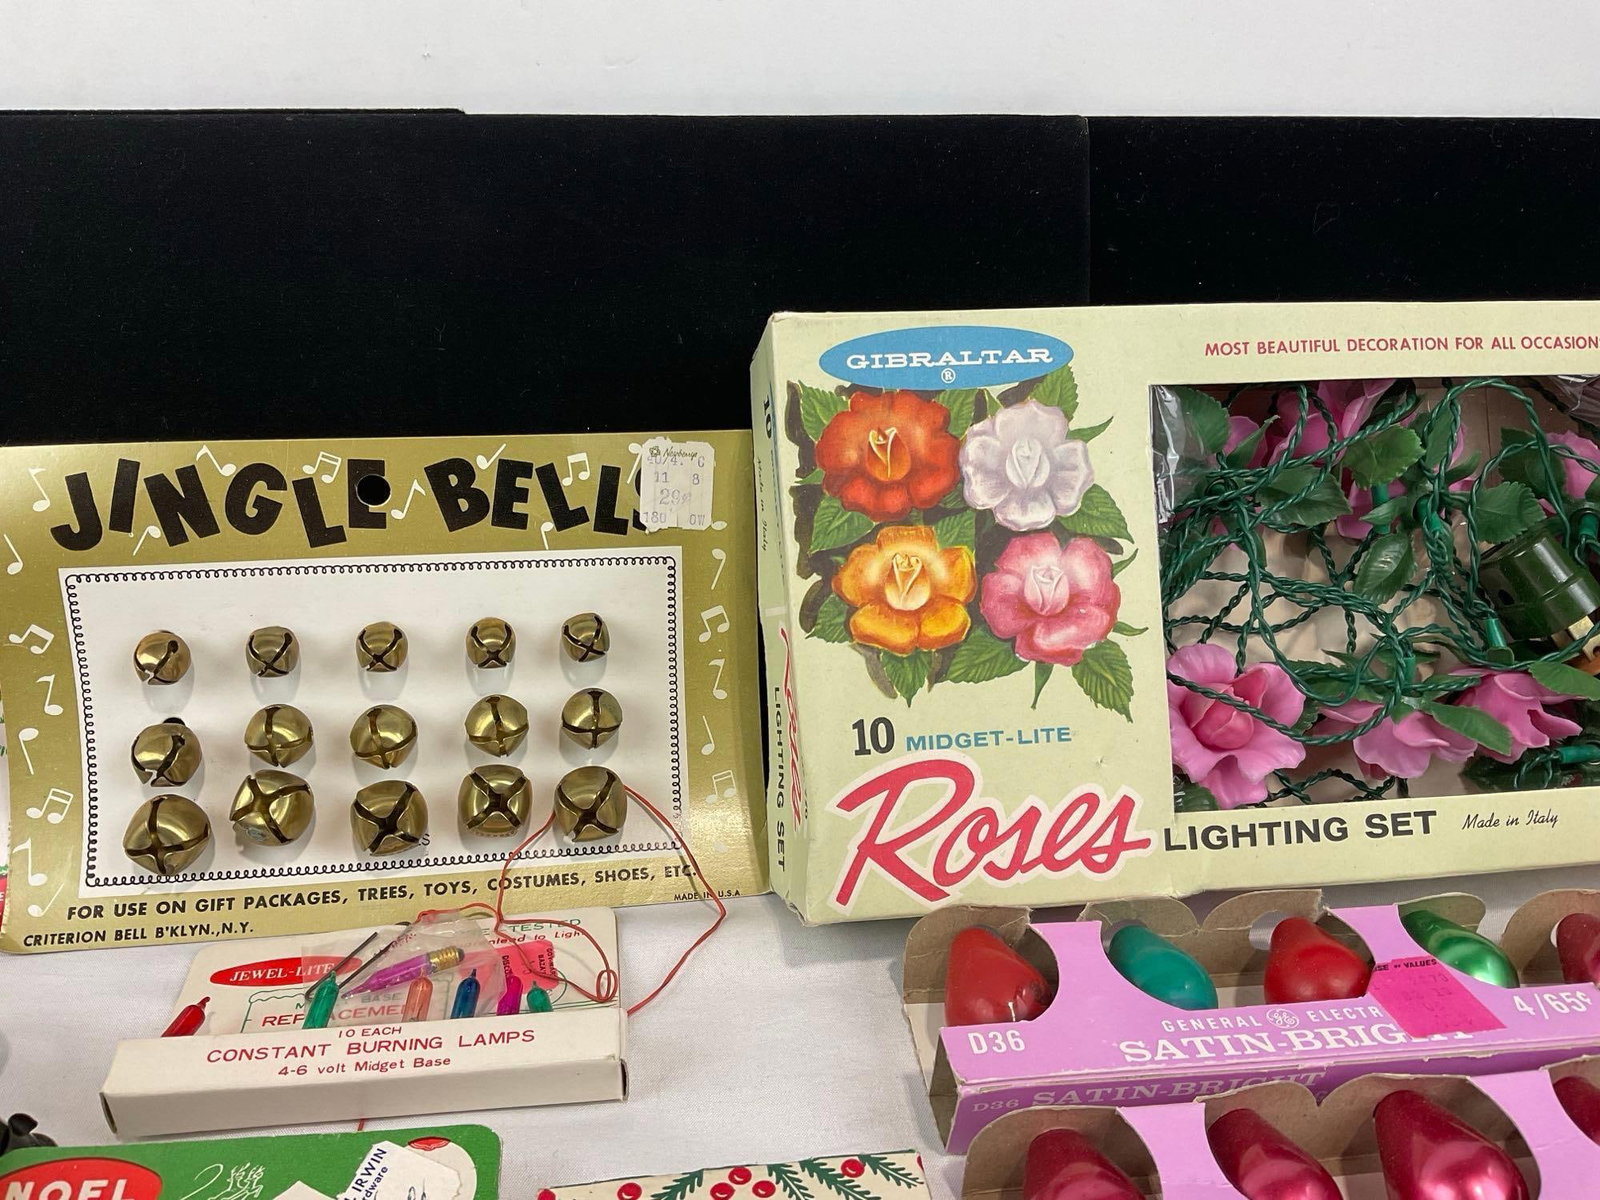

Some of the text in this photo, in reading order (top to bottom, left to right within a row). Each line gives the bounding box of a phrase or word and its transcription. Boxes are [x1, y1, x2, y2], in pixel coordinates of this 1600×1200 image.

[846, 347, 1054, 370] GIBRALTAR
[1205, 336, 1600, 356] MOST BEAUTIFUL DECORATION FOR ALL OCCASION
[692, 474, 700, 485] 8
[50, 458, 647, 552] JINGLE BELL
[852, 716, 1072, 756] 10 MIDGET-LITE
[774, 687, 785, 872] LIGHTING SET
[1164, 809, 1437, 852] LIGHTING SET
[1462, 808, 1560, 830] Made in Italy
[836, 758, 1151, 907] Roses
[67, 904, 105, 921] FOR
[114, 901, 147, 919] USE
[156, 899, 187, 915] ON
[195, 896, 235, 914] GIFT
[243, 889, 349, 911] PACKAGES,
[358, 884, 414, 902] TREES,
[423, 880, 478, 898] TOYS,
[487, 871, 586, 892] COSTUMES,
[594, 866, 656, 884] SHOES,
[674, 892, 698, 901] MADE
[23, 930, 107, 948] CRITERION
[114, 927, 148, 942] BELL
[554, 930, 580, 939] Ligh
[229, 962, 336, 983] JEWEL-LITE
[1512, 990, 1593, 1020] 4/65¢
[1161, 1014, 1262, 1033] GENERAL
[1305, 1005, 1384, 1024] ELECTR
[338, 1026, 402, 1038] 10 EACH
[967, 1030, 1026, 1055] D36
[1119, 1021, 1473, 1063] SATIN-BRIG
[207, 1029, 535, 1063] CONSTANT BURNING LAMPS
[278, 1057, 450, 1076] 4-6 volt Midget Base
[973, 1099, 1020, 1112] D36
[352, 1147, 388, 1192] IRWIN
